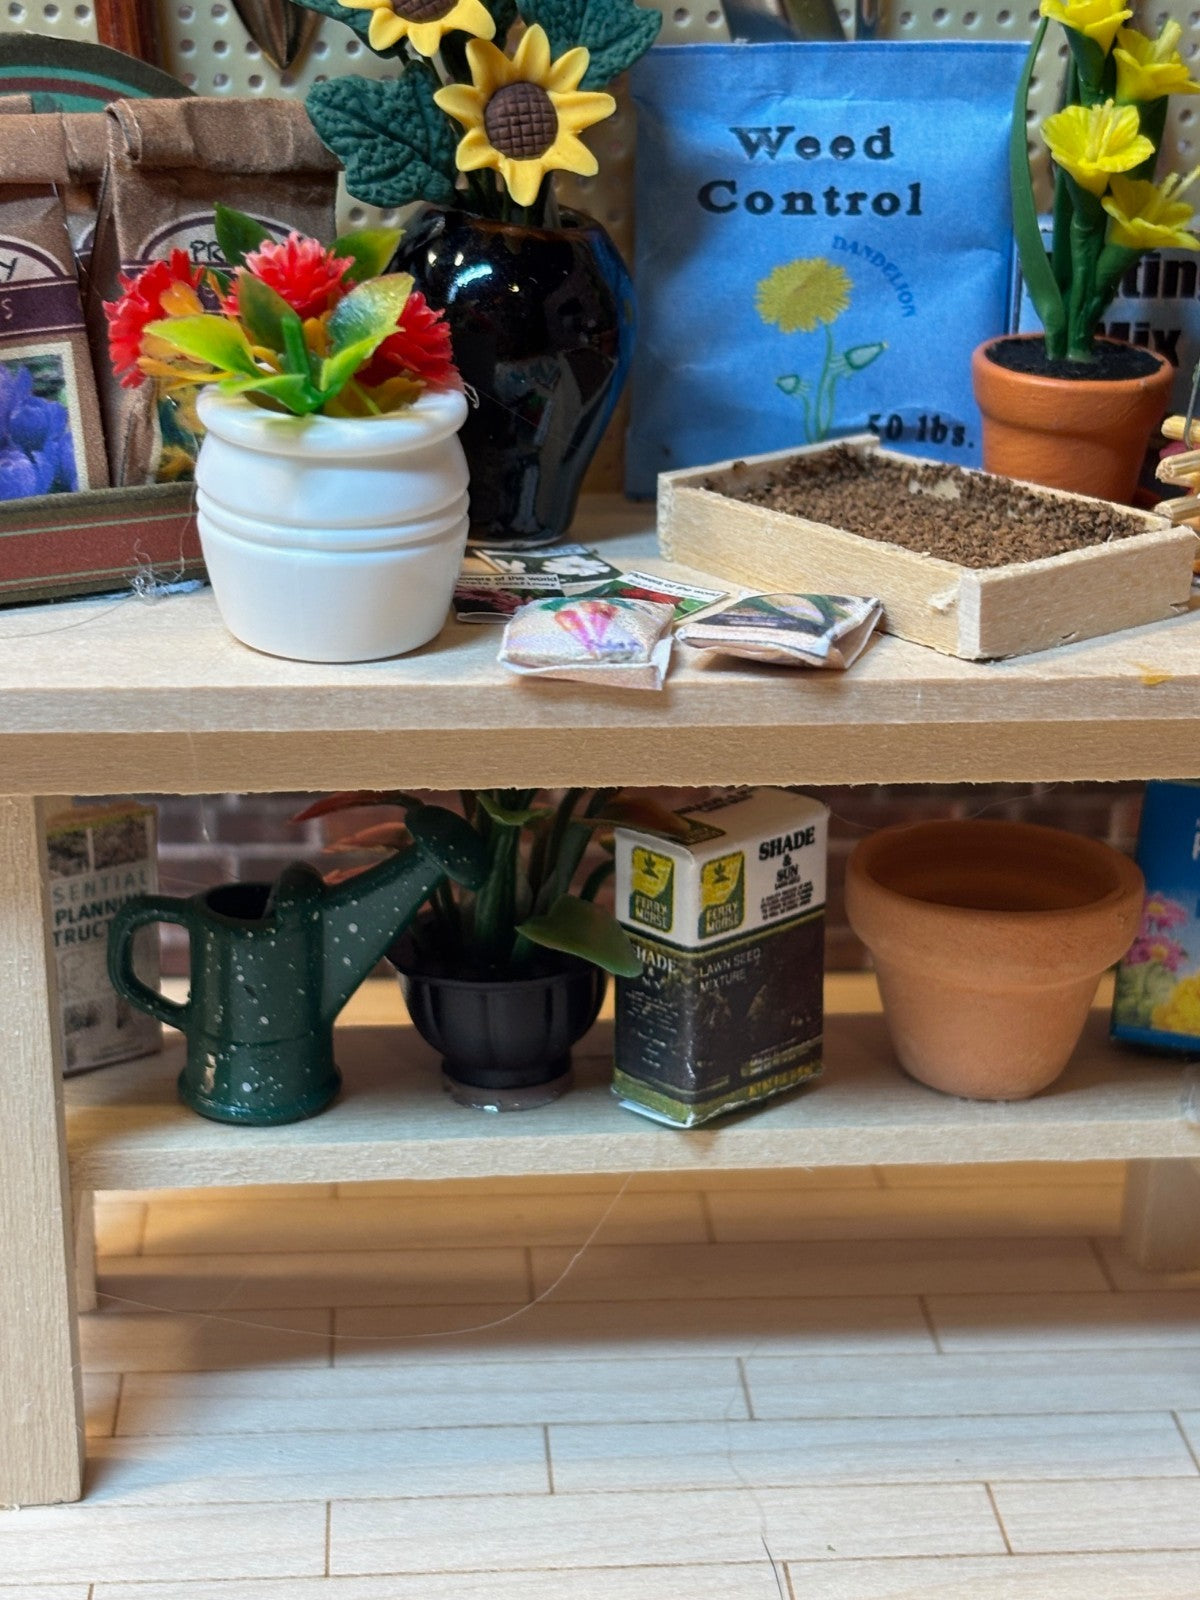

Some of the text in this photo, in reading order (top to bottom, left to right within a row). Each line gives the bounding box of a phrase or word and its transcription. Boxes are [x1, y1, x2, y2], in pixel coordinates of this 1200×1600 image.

[729, 125, 895, 160] Weed
[698, 180, 922, 216] Control
[832, 235, 916, 318] DANDELION
[866, 412, 974, 449] 50 lbs.
[758, 825, 815, 860] SHADE
[782, 853, 792, 867] &
